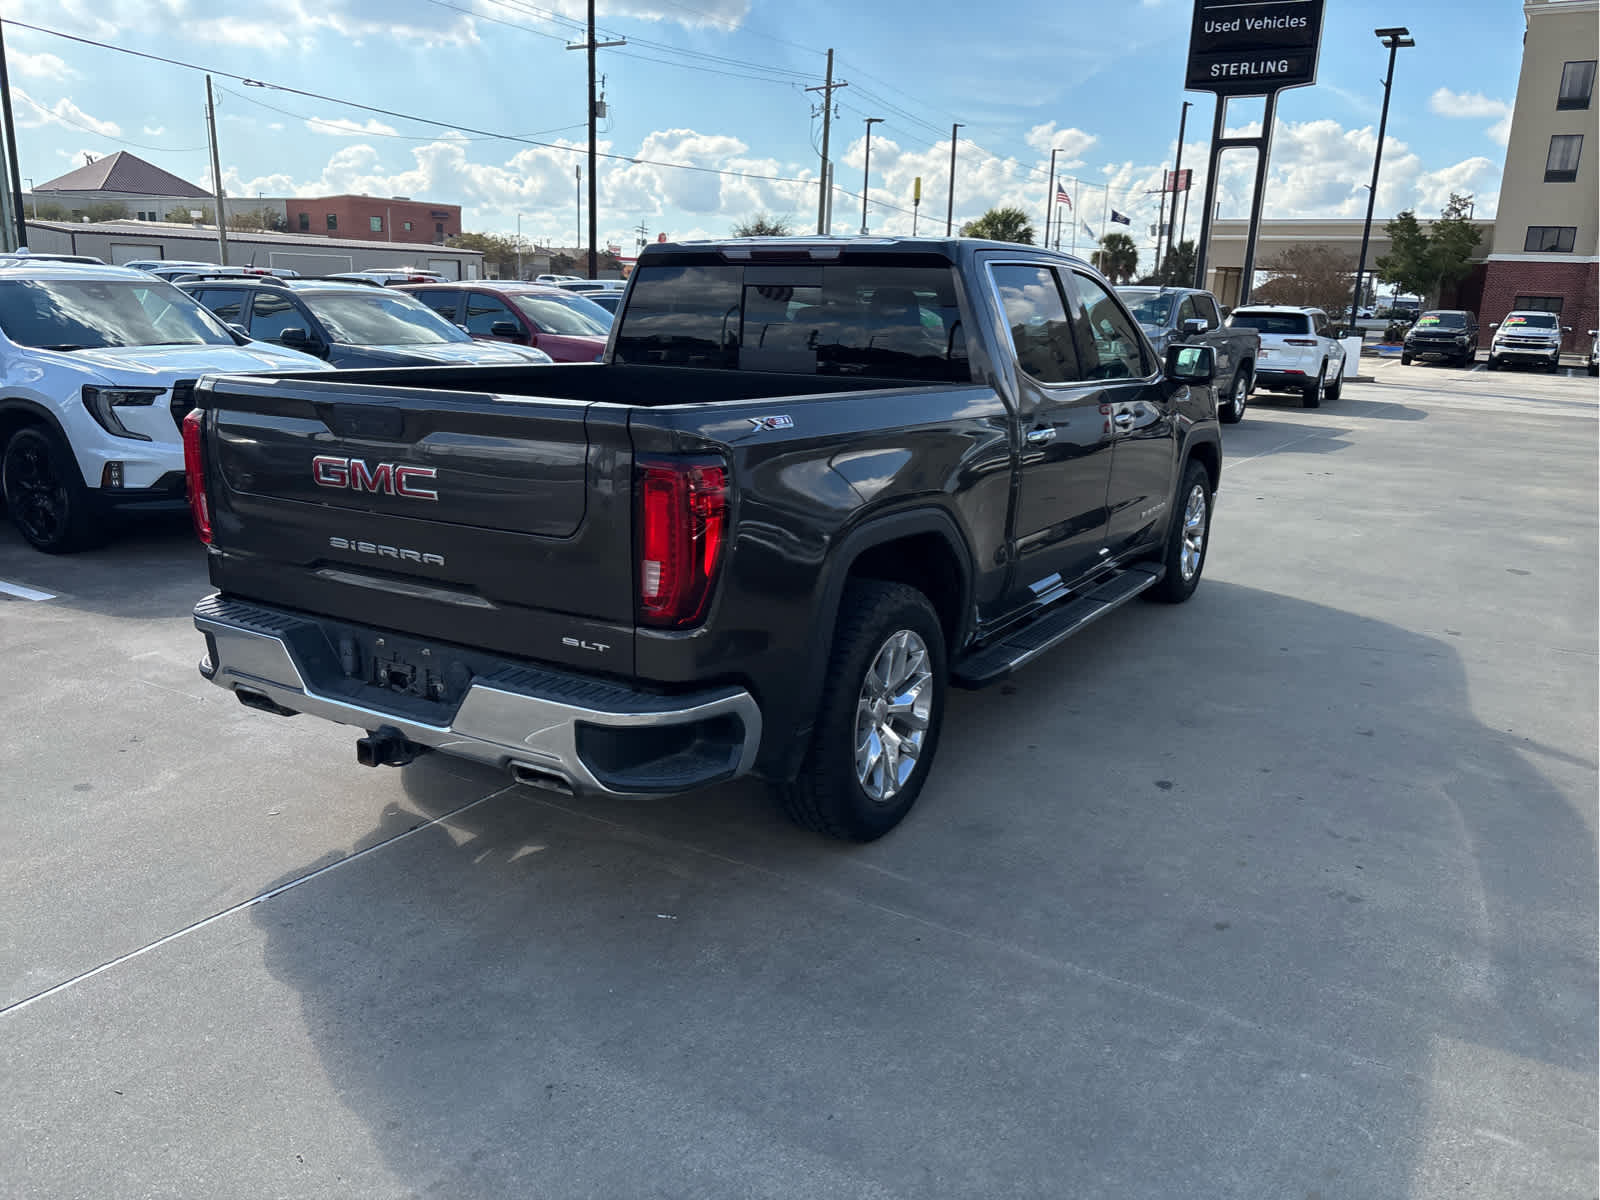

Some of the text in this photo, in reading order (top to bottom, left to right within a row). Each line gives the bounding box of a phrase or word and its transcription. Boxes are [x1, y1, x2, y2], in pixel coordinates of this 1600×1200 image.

[1204, 15, 1308, 33] Used Vehicles
[1210, 60, 1289, 77] STERLING
[313, 455, 439, 501] GMC
[329, 537, 446, 566] SIERRA
[562, 637, 611, 652] SLT
